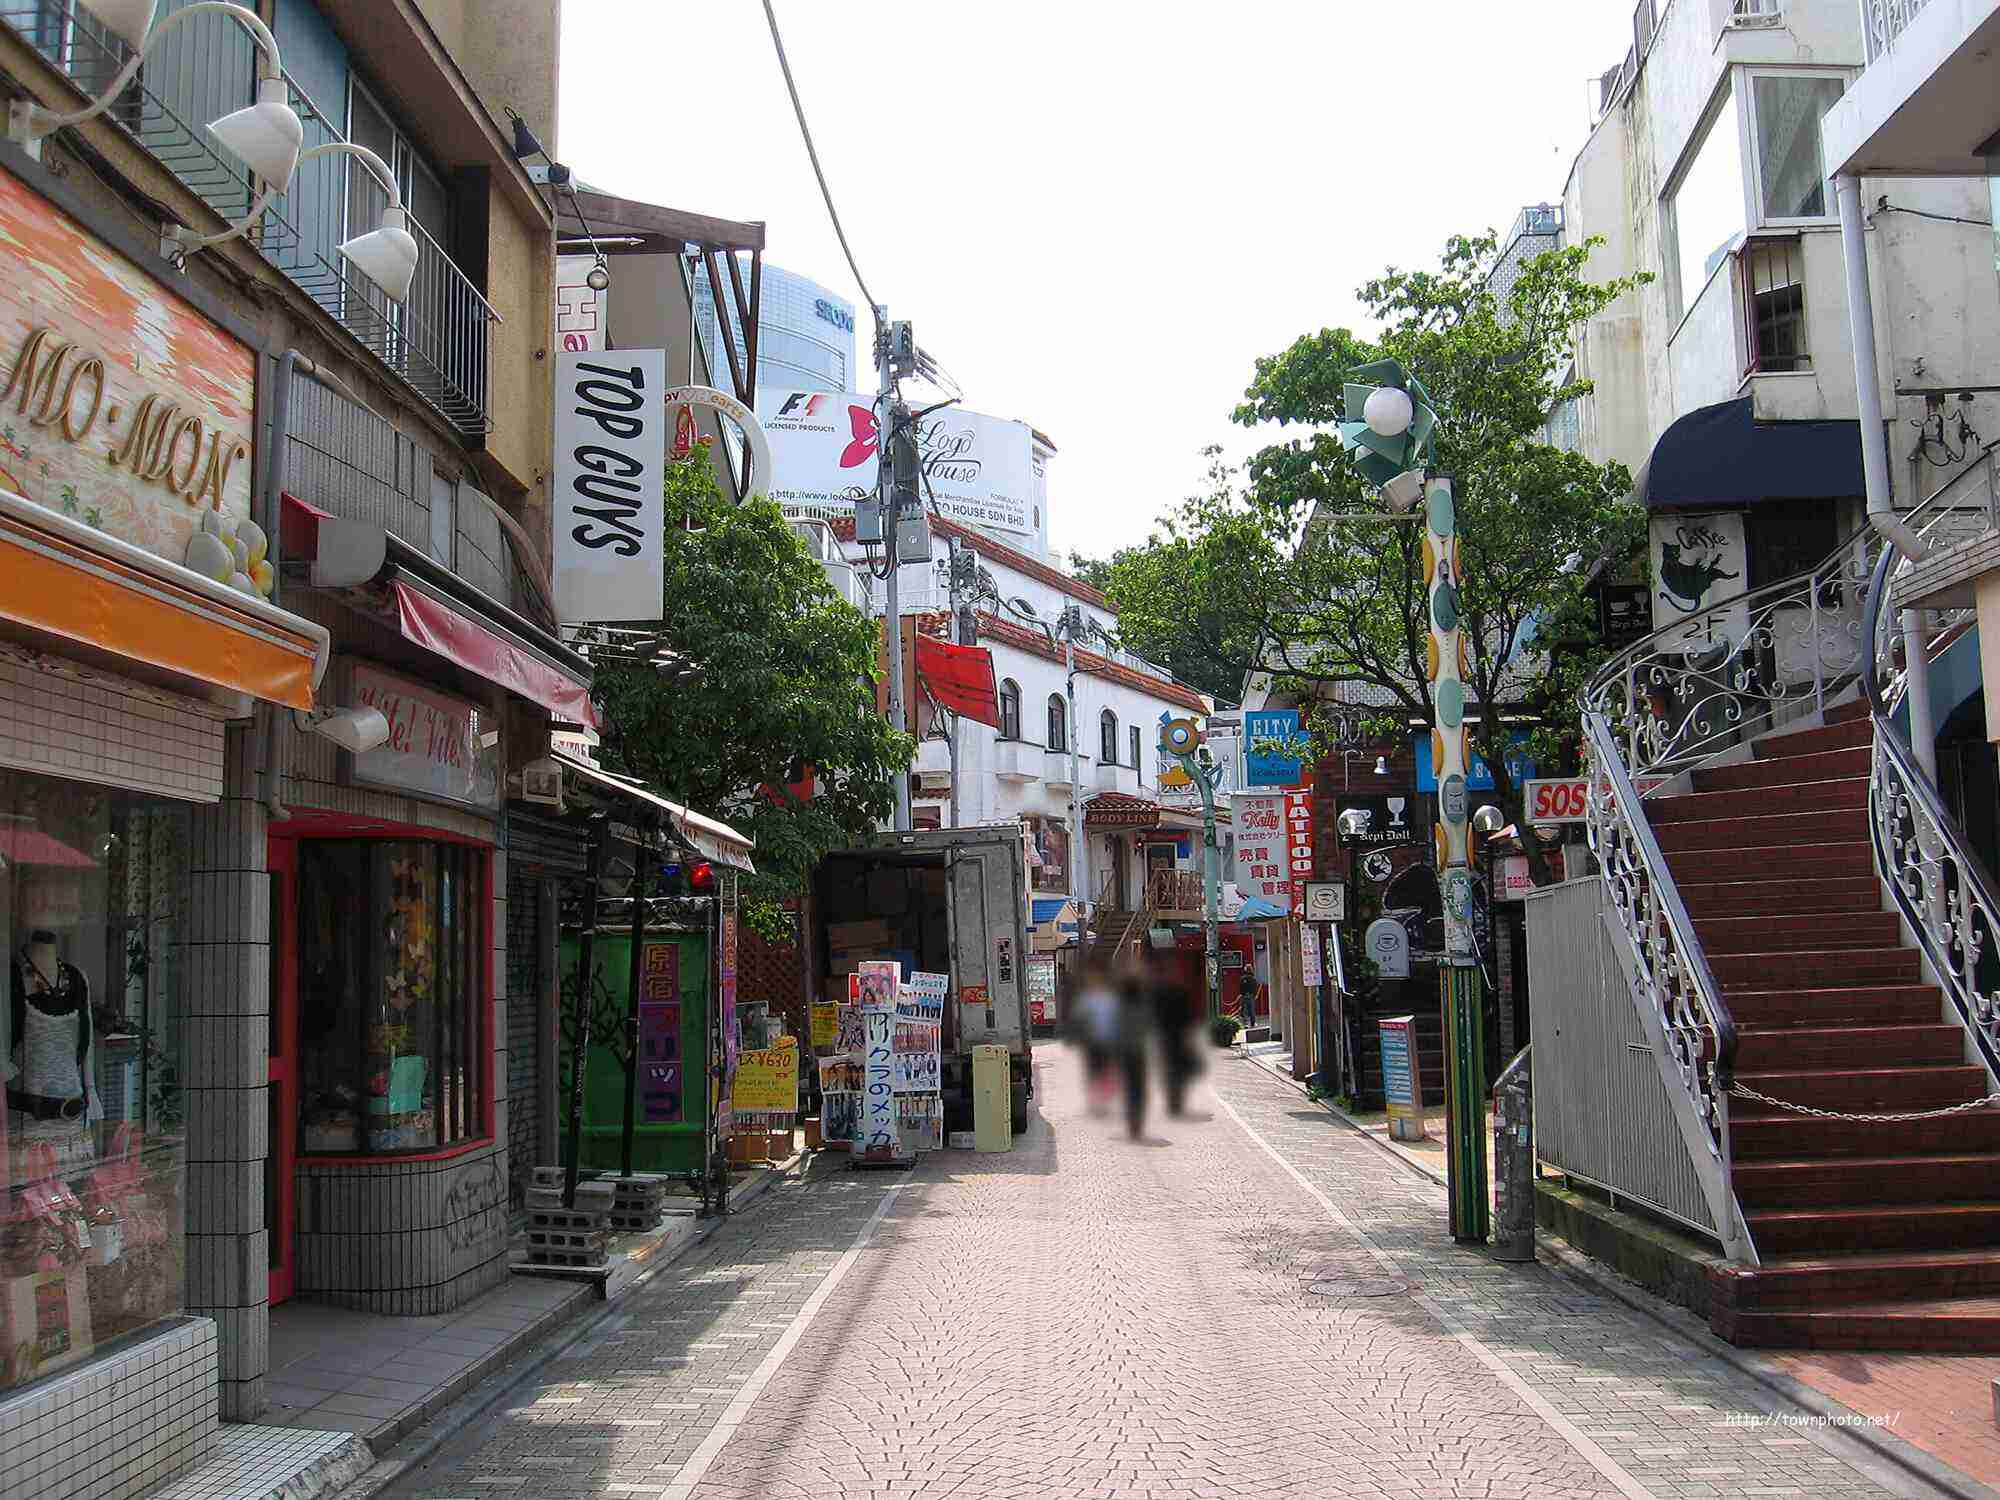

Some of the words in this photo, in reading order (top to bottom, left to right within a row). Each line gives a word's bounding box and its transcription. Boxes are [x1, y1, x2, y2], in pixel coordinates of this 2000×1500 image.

[574, 362, 645, 440] TOP
[920, 420, 977, 459] Logo
[571, 445, 644, 557] GUYS
[952, 504, 986, 518] HOUSE
[988, 510, 1006, 522] SDN
[1007, 514, 1025, 527] BHD
[1676, 526, 1729, 550] Coffee
[1252, 718, 1292, 735] CITY
[1287, 793, 1313, 871] TATTOO
[1239, 848, 1269, 862] 売買
[1262, 880, 1290, 896] 管理
